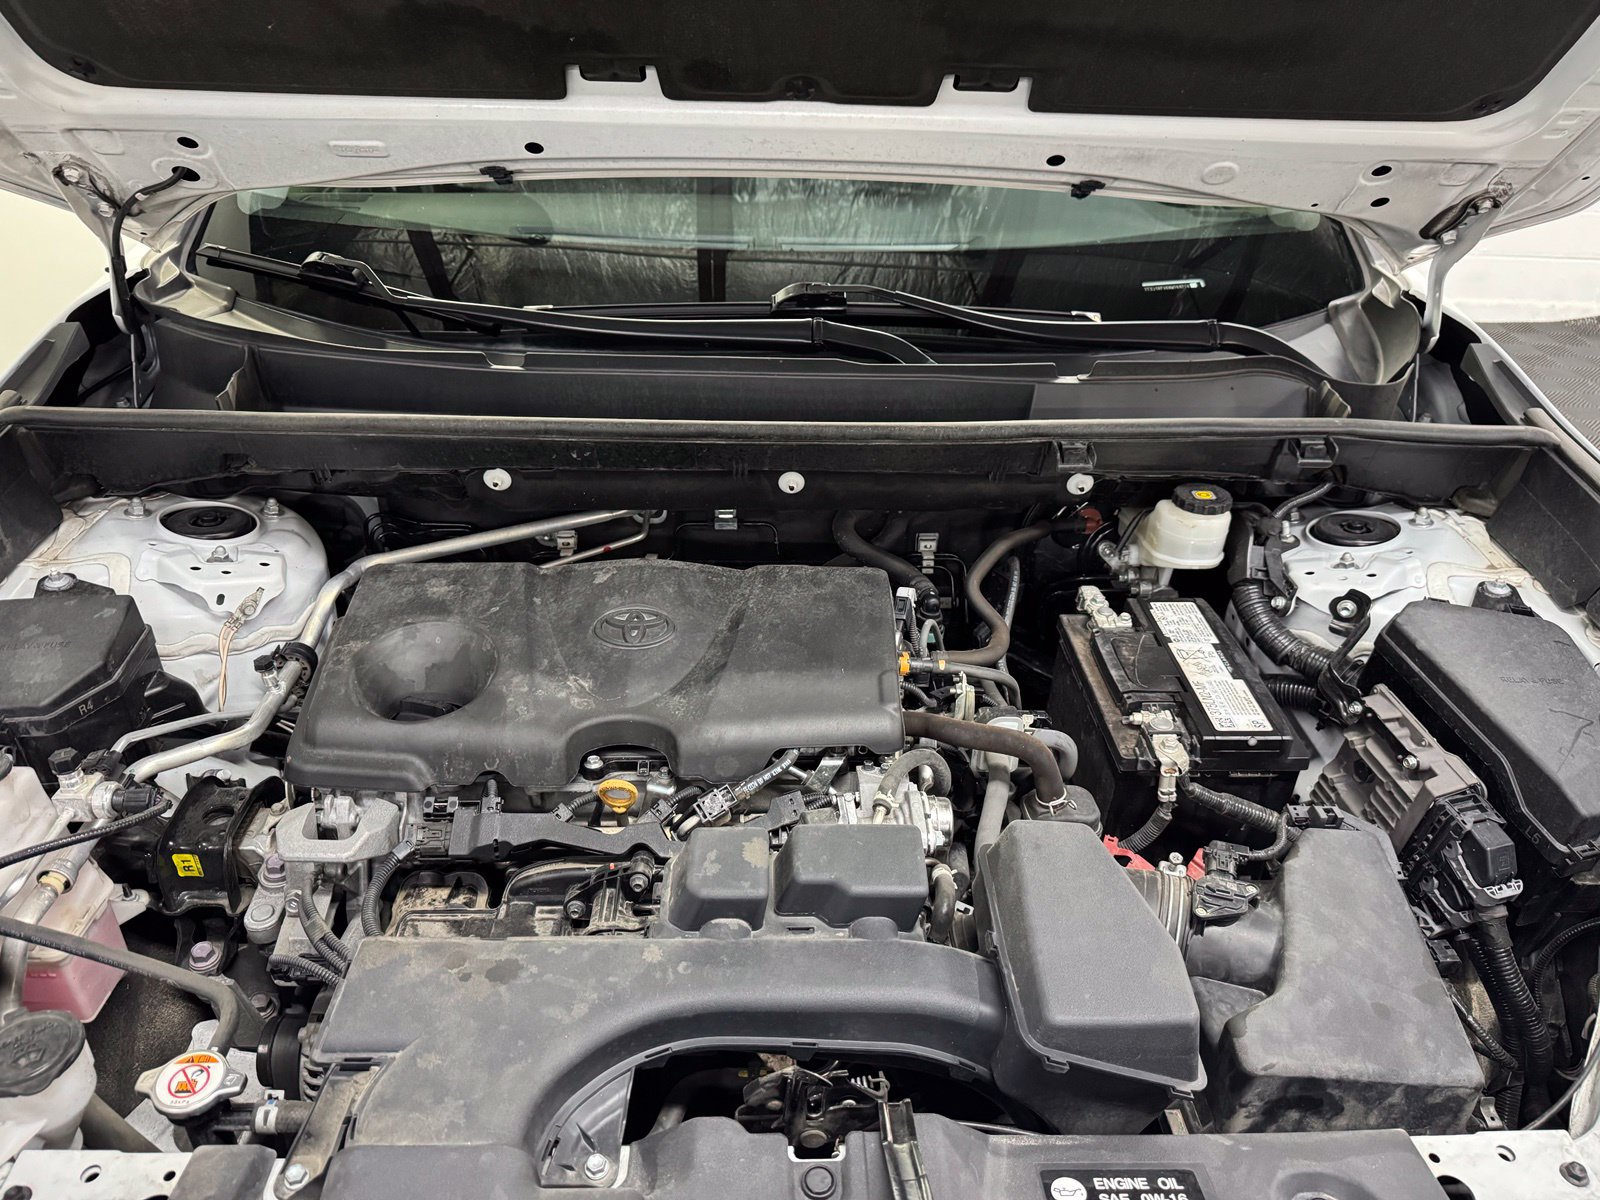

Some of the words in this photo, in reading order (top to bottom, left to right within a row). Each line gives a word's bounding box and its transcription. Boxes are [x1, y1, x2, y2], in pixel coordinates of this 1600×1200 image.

[78, 699, 94, 716] R4
[181, 859, 195, 872] R1
[1093, 1177, 1150, 1190] ENGINE
[1157, 1177, 1184, 1190] OIL
